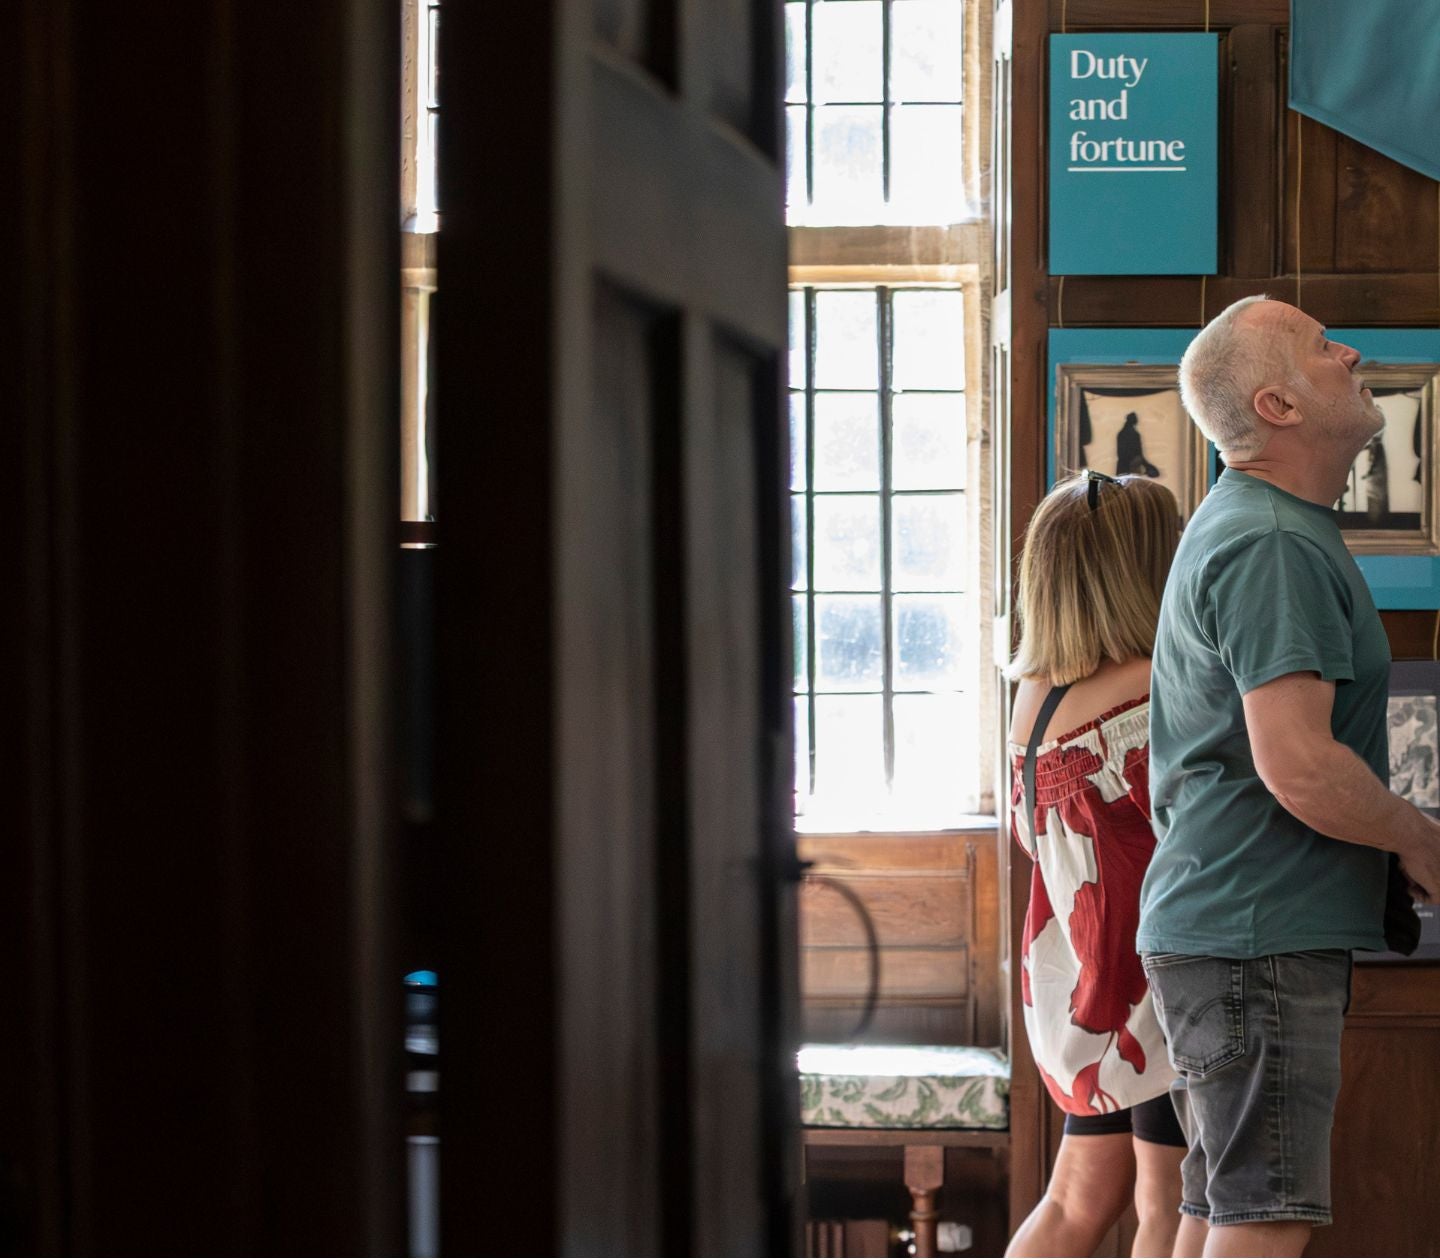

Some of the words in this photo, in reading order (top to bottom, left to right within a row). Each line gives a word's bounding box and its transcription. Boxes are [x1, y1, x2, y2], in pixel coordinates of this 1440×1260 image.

[1070, 49, 1148, 88] Duty
[1069, 89, 1128, 121] and
[1070, 130, 1185, 162] fortune
